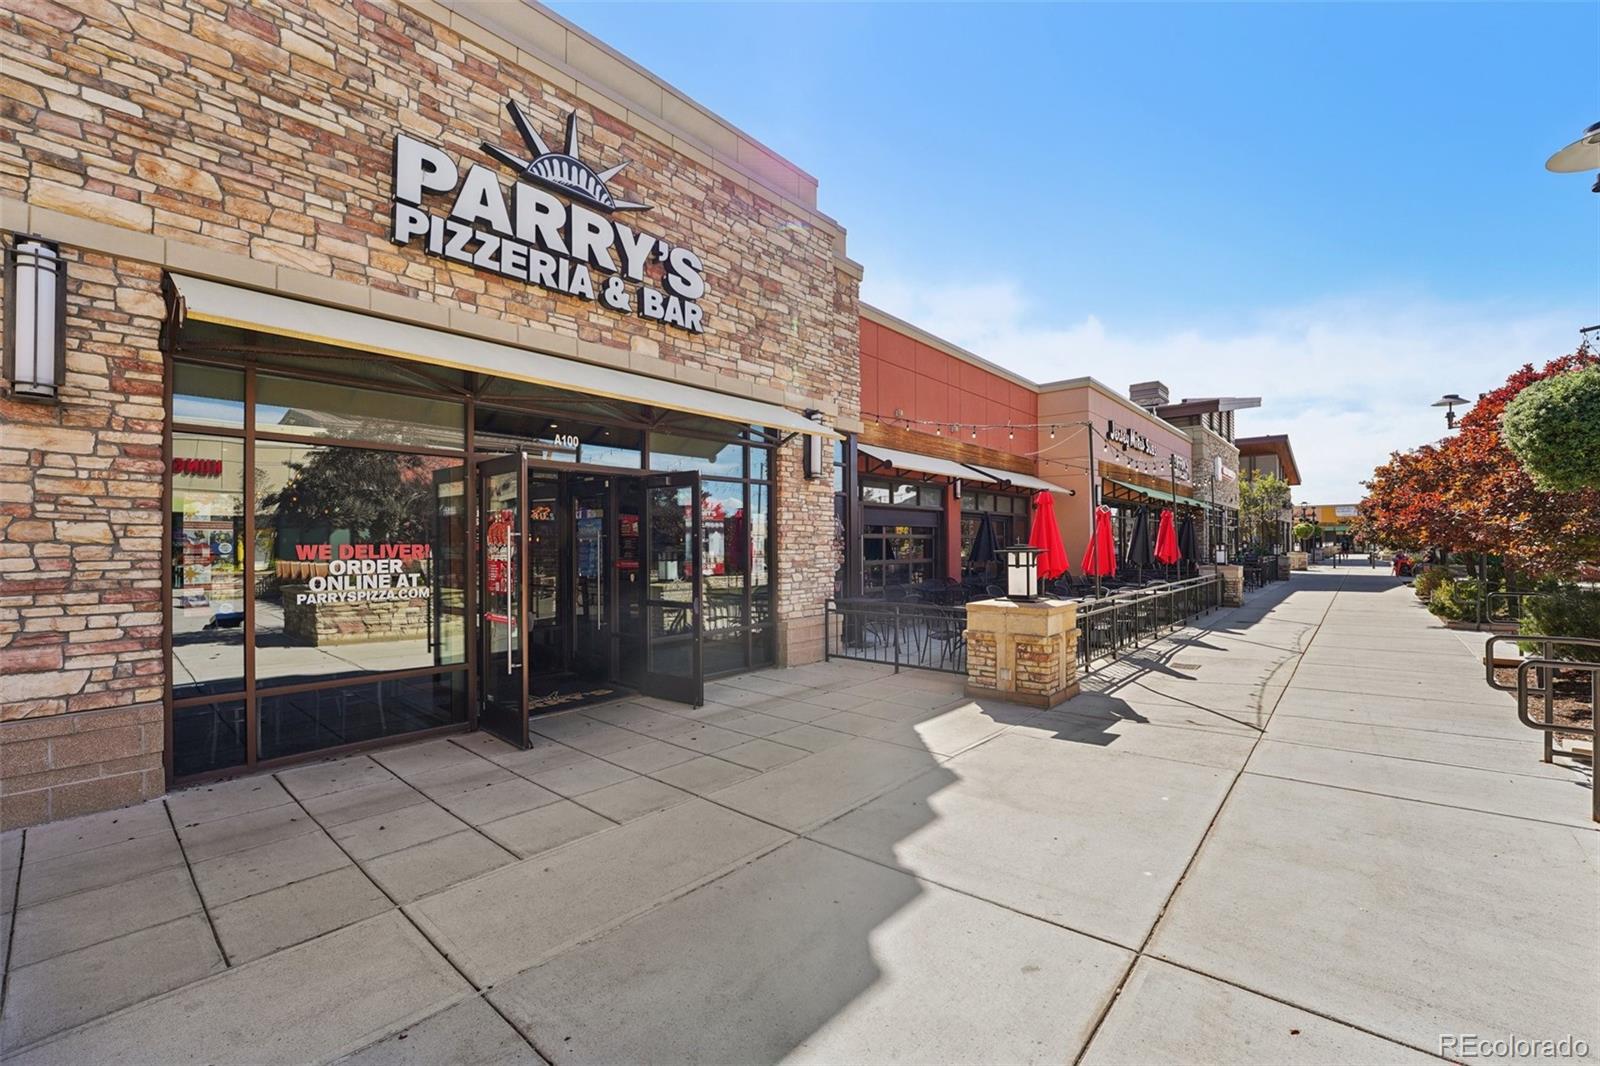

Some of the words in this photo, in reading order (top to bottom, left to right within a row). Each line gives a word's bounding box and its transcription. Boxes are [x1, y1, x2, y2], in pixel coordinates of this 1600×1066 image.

[392, 133, 705, 300] PARRY'S
[391, 202, 595, 302] PIZZERIA
[598, 275, 632, 314] &
[637, 286, 704, 334] BAR
[554, 433, 579, 448] A100
[295, 544, 332, 561] WE
[338, 543, 430, 560] DELIVER!
[329, 559, 404, 576] ORDER
[308, 575, 391, 592] ONLINE
[396, 573, 420, 588] AT
[296, 587, 430, 605] PARRYSPIZZA.COM
